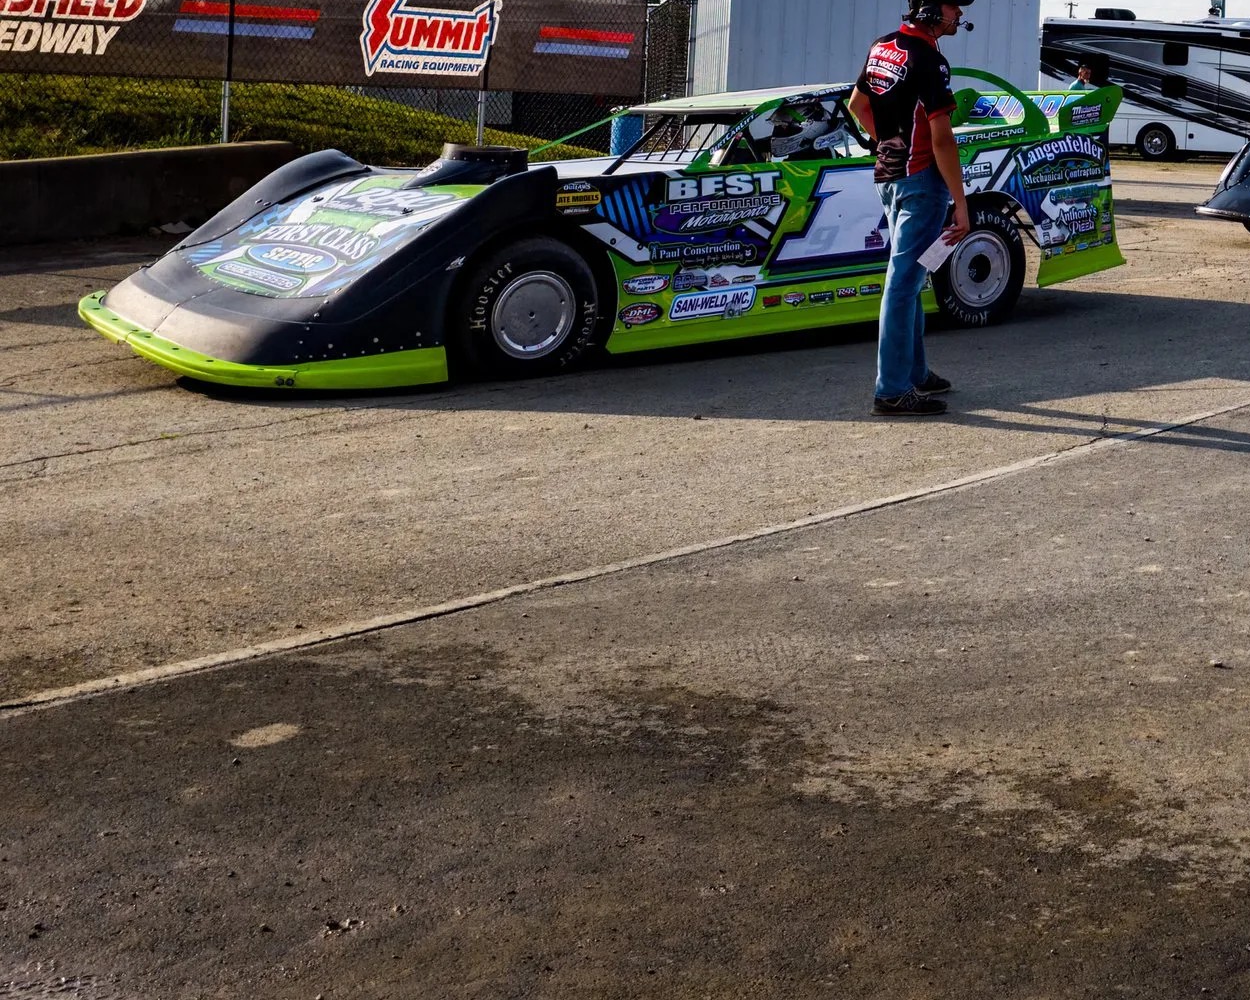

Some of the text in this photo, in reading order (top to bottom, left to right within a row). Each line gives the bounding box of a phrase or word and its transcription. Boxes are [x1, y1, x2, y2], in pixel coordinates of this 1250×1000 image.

[380, 59, 482, 73] RACING EQUIPMENT
[878, 60, 903, 77] MODEL
[969, 94, 1087, 119] SUO
[1016, 135, 1104, 172] Langenfelder
[668, 170, 781, 201] BEST
[1023, 166, 1102, 185] Mechanical Contractors
[670, 194, 780, 215] PERFORMANCE
[1056, 204, 1098, 227] Anthony's
[680, 205, 769, 230] Motorsports
[251, 224, 376, 260] FIRST CLASS
[660, 243, 741, 259] Paul Construction
[262, 246, 325, 268] SEPTIC
[731, 291, 750, 305] INC.
